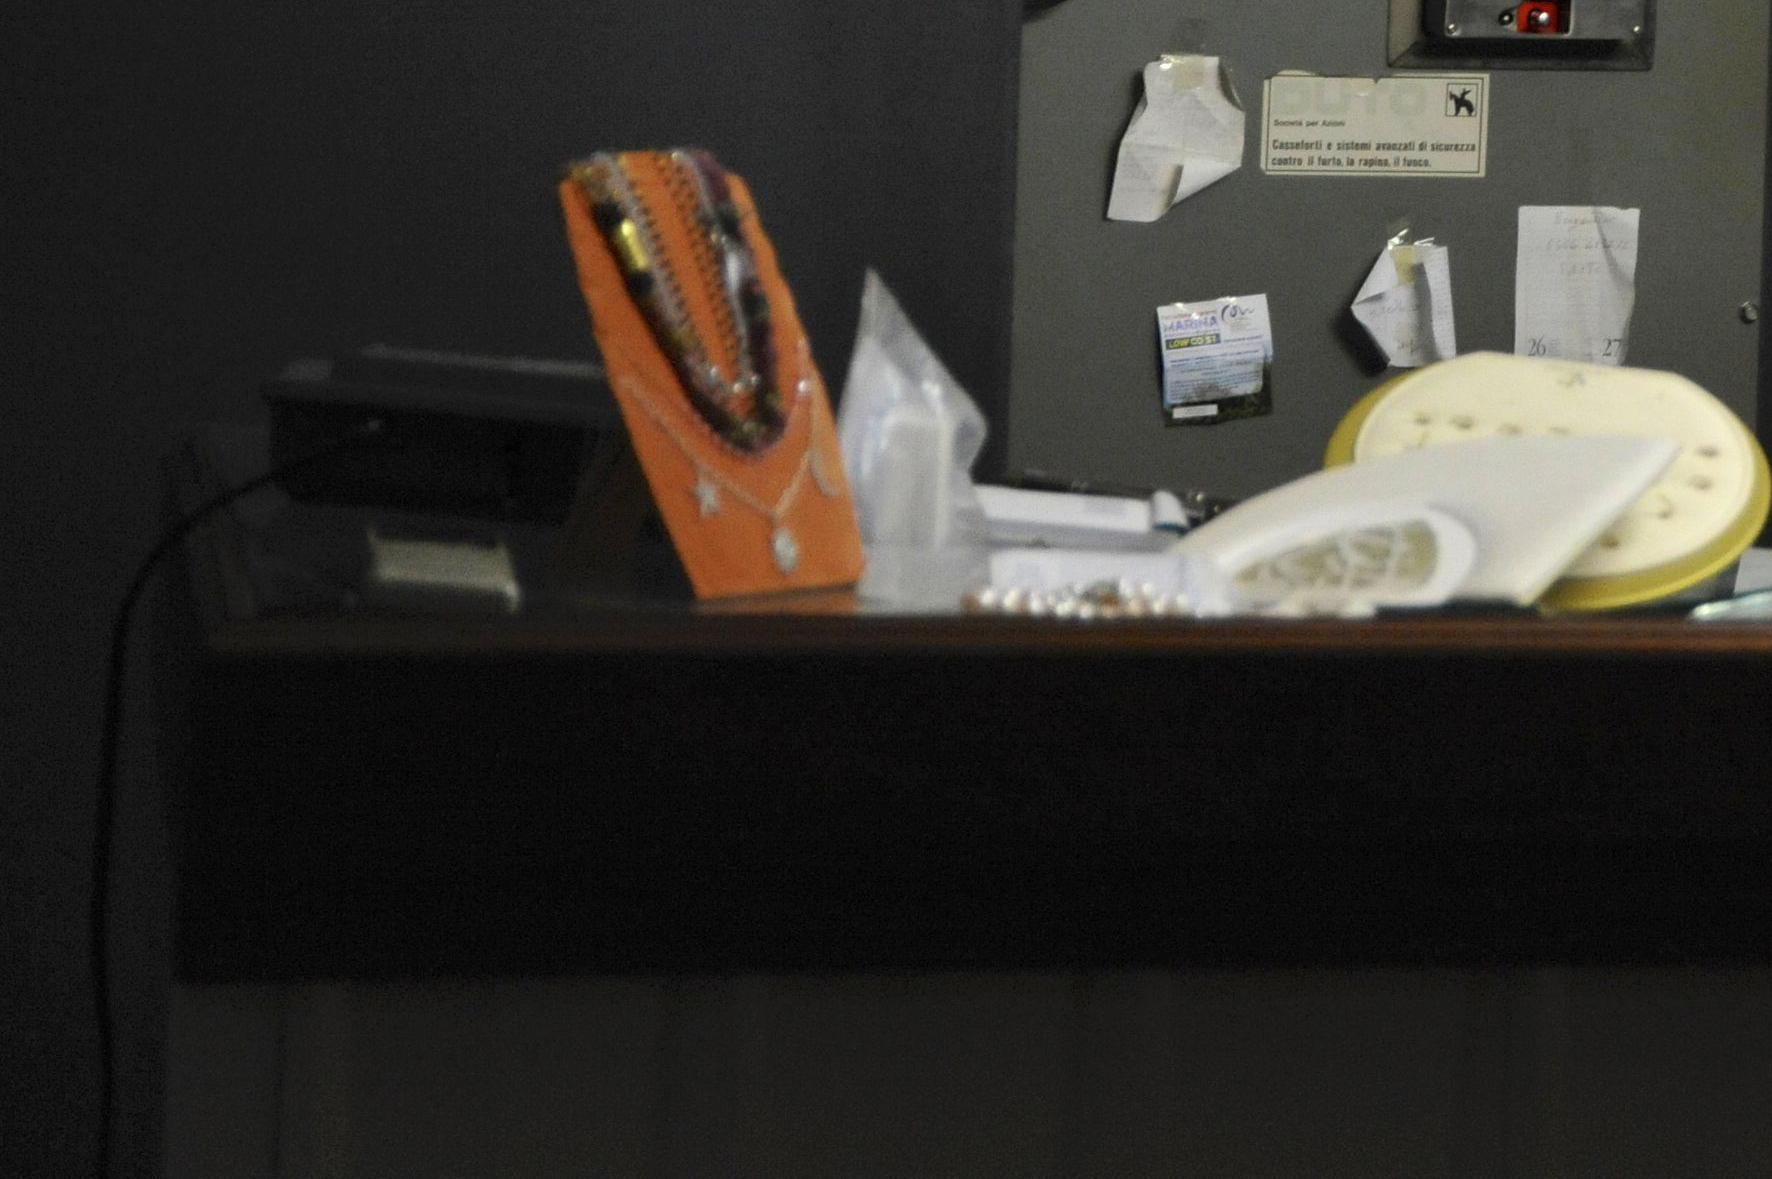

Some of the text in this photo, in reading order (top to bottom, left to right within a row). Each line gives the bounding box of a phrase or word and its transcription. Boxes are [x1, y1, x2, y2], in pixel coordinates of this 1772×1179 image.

[1272, 139, 1476, 152] Casseforti e sistemi avanzati di sicurezza
[1271, 157, 1303, 167] contro
[1307, 156, 1315, 167] il
[1346, 156, 1355, 167] la
[1393, 156, 1401, 167] il
[1168, 338, 1189, 349] LOW
[1527, 335, 1546, 357] 26
[1602, 338, 1623, 357] 27
